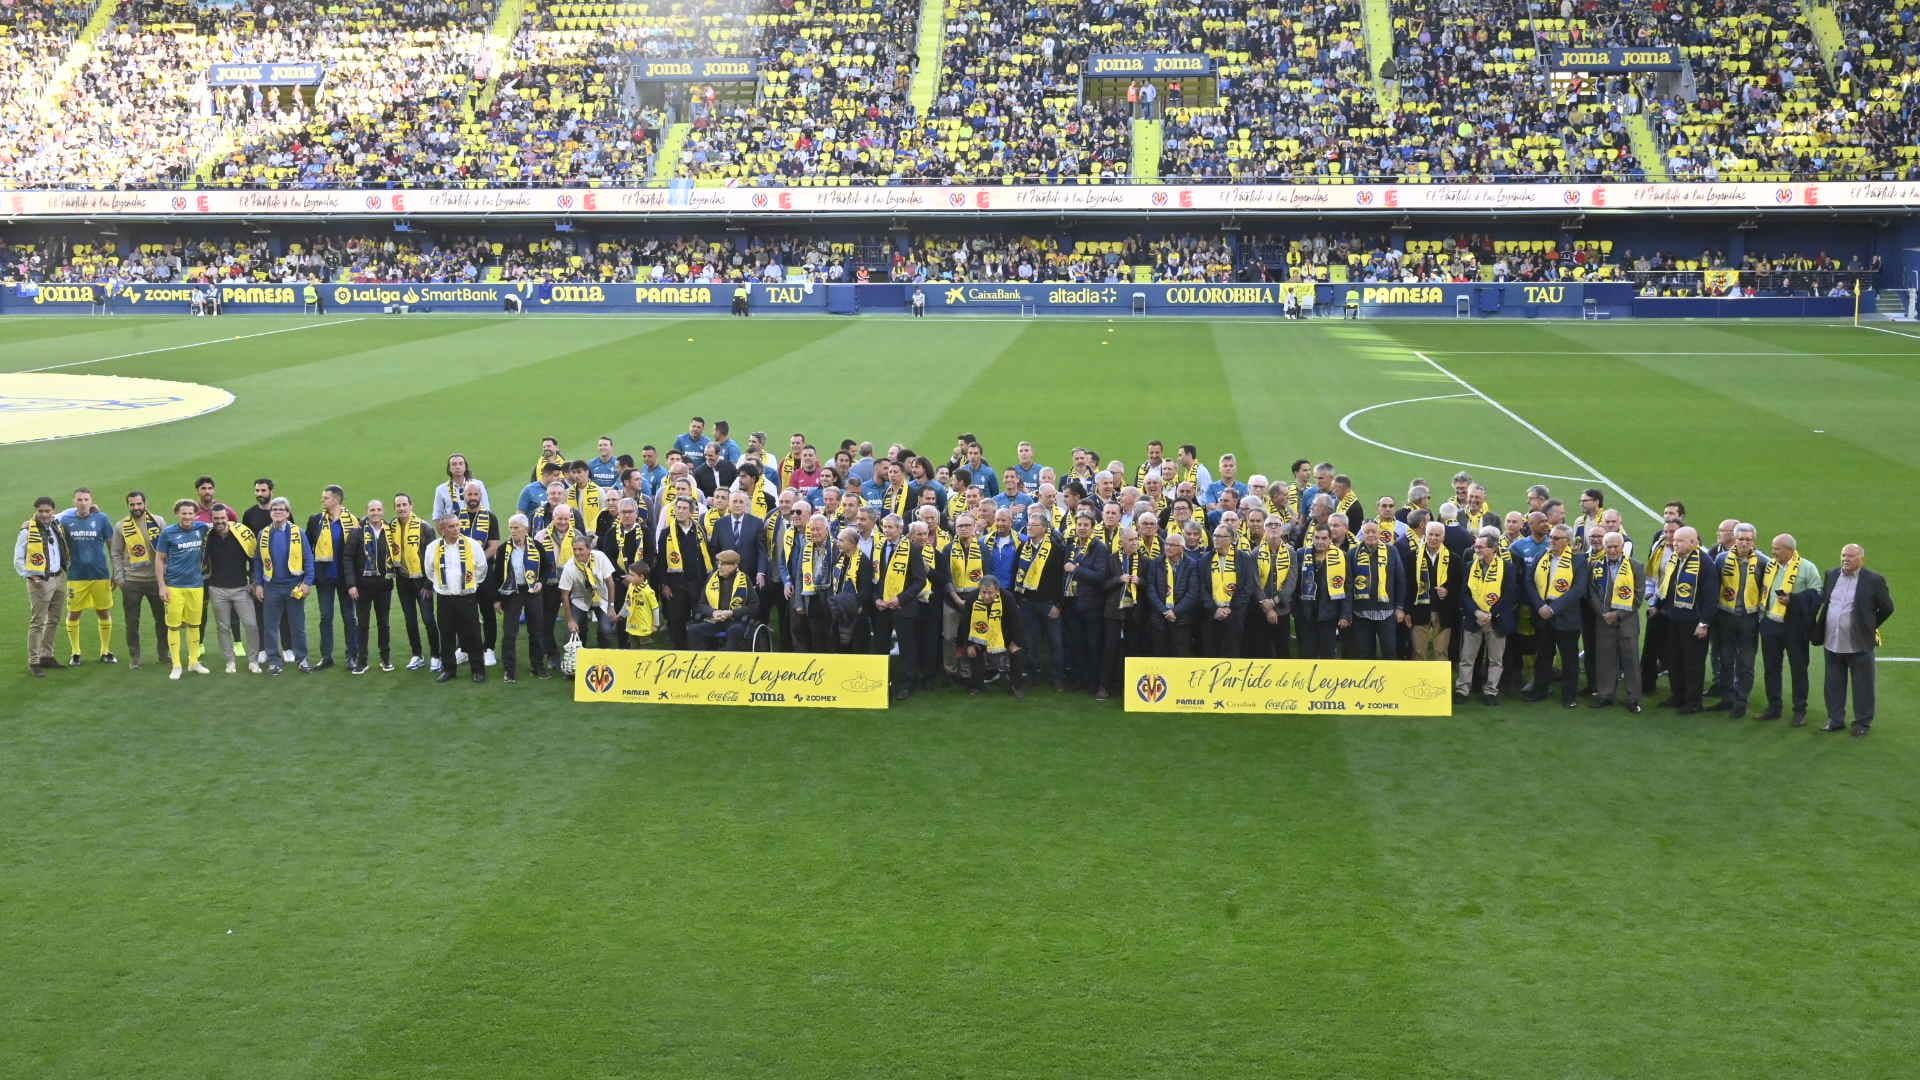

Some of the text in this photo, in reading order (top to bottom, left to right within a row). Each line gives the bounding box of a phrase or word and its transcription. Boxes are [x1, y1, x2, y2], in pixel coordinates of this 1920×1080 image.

[145, 289, 192, 301] ZOOME
[223, 287, 294, 303] PAMESA
[353, 287, 497, 304] LaLiga SmartBank
[635, 287, 711, 303] PAMESA
[766, 287, 803, 303] TAU
[968, 288, 1021, 300] CaixaBank
[1049, 287, 1099, 303] altadia
[1166, 287, 1274, 303] COLOROBBIA
[1363, 287, 1443, 303] PAMESA
[1523, 287, 1566, 303] TAU
[633, 661, 652, 679] El
[654, 653, 716, 684] Partido
[718, 664, 731, 678] de
[749, 656, 825, 691] Leyendas
[1188, 669, 1206, 688] El
[1208, 661, 1273, 694] Partido
[1275, 672, 1288, 687] de
[1307, 664, 1385, 699] Leyendas
